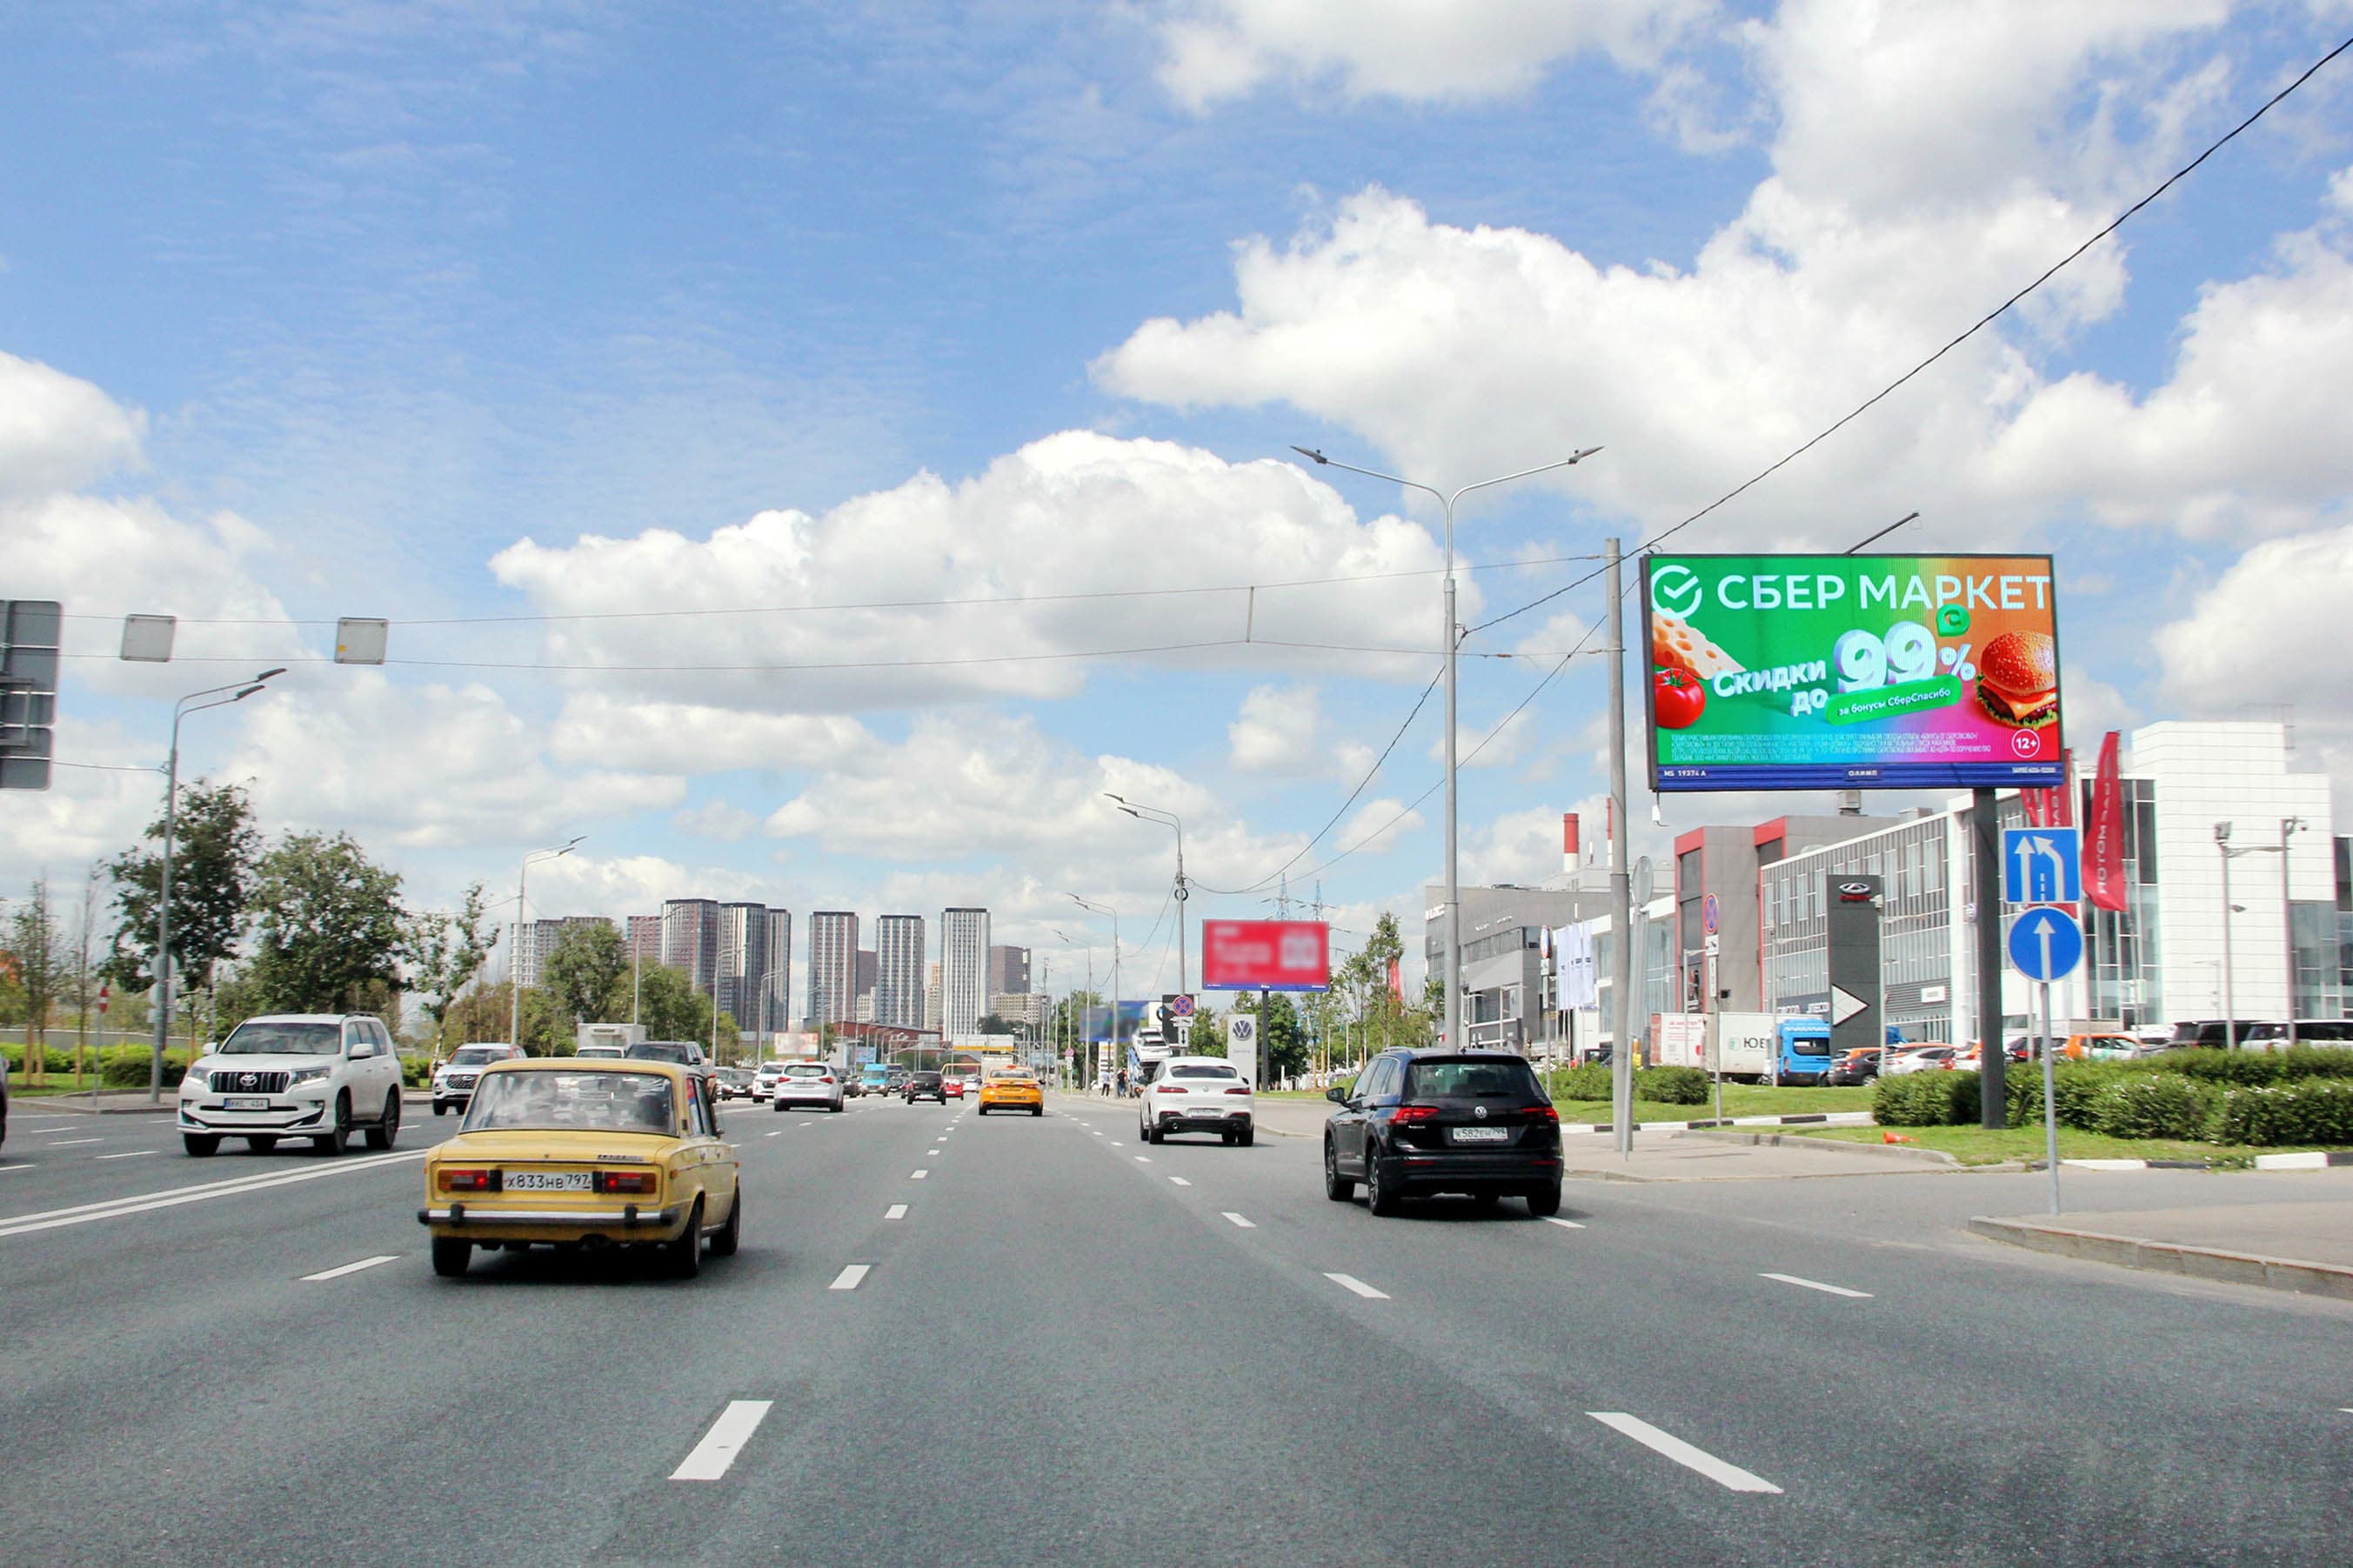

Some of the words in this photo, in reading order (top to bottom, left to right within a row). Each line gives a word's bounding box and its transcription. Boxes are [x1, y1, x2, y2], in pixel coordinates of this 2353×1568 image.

[1717, 574, 1845, 610] СБЕР
[1859, 574, 2051, 611] МАРКЕТ
[1712, 659, 1827, 697] Скидки
[1790, 687, 1829, 717] до
[1838, 707, 1849, 717] за
[1851, 700, 1886, 715] бонусы
[1888, 687, 1951, 707] СберСпасибо
[2015, 737, 2038, 750] 12+
